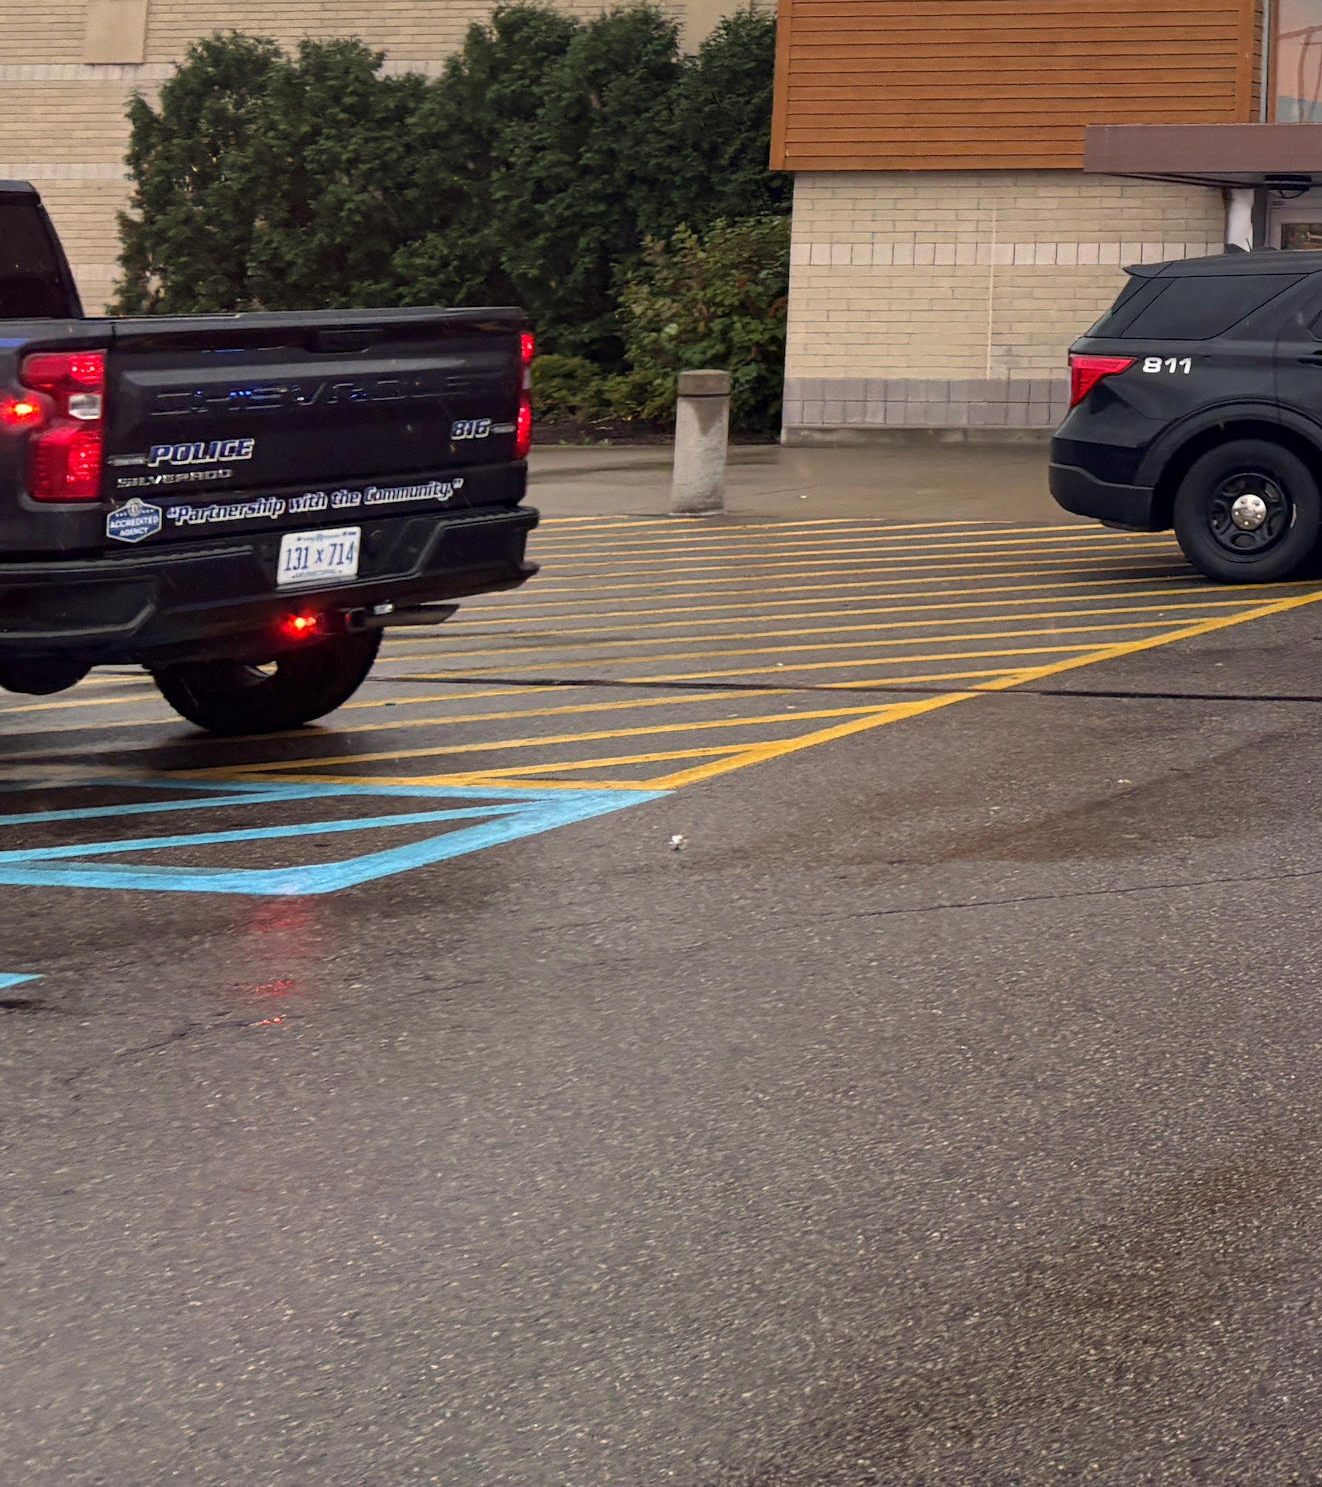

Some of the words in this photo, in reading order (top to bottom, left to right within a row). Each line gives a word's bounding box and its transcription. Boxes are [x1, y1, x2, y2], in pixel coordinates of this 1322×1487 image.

[1142, 357, 1192, 374] 811
[451, 418, 491, 440] 816
[148, 438, 255, 467] POLICE
[116, 469, 233, 489] SILVERADO
[288, 492, 328, 513] with
[331, 489, 362, 508] the
[110, 514, 160, 529] ACCREDITED
[119, 526, 149, 536] AGENCY
[284, 546, 310, 571] 131
[328, 540, 355, 566] 714
